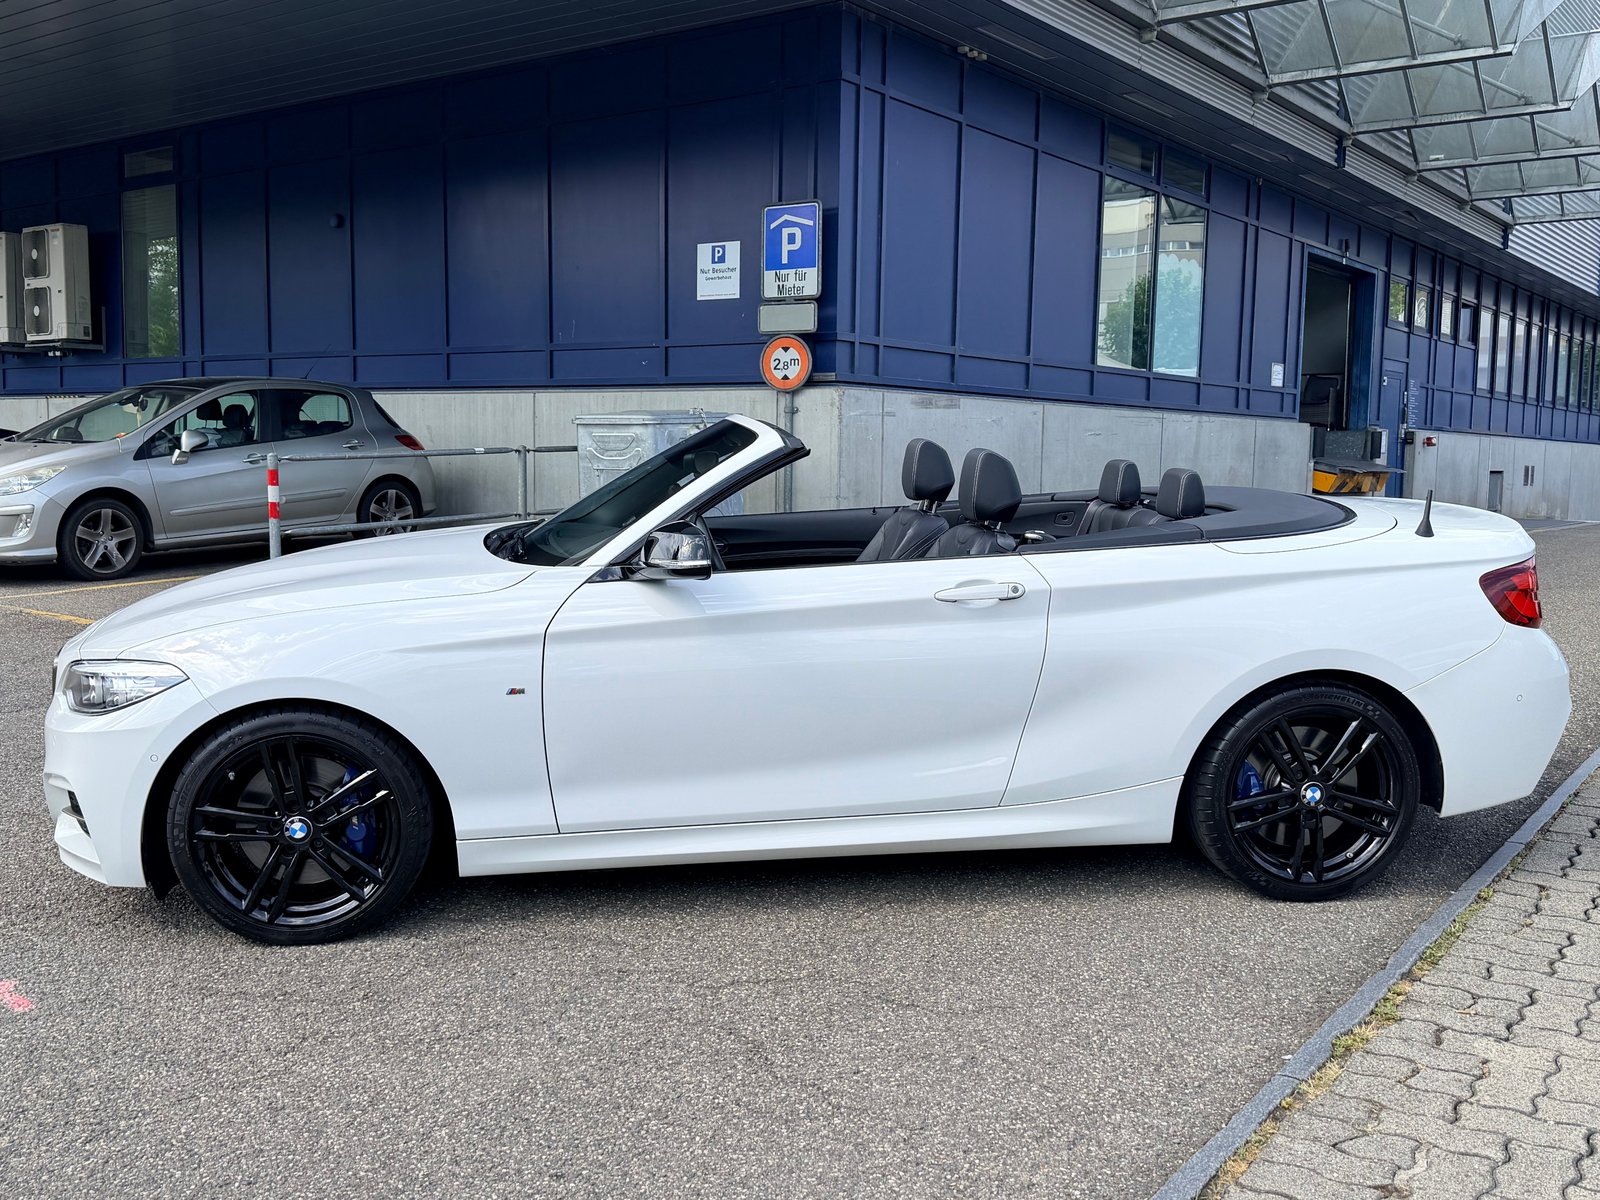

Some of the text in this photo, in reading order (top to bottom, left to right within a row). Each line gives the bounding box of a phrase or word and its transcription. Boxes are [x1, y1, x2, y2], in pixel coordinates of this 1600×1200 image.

[782, 227, 802, 264] P
[715, 247, 723, 262] P
[712, 266, 737, 274] Besucher
[774, 269, 807, 282] Nur für
[777, 284, 805, 296] Mieter
